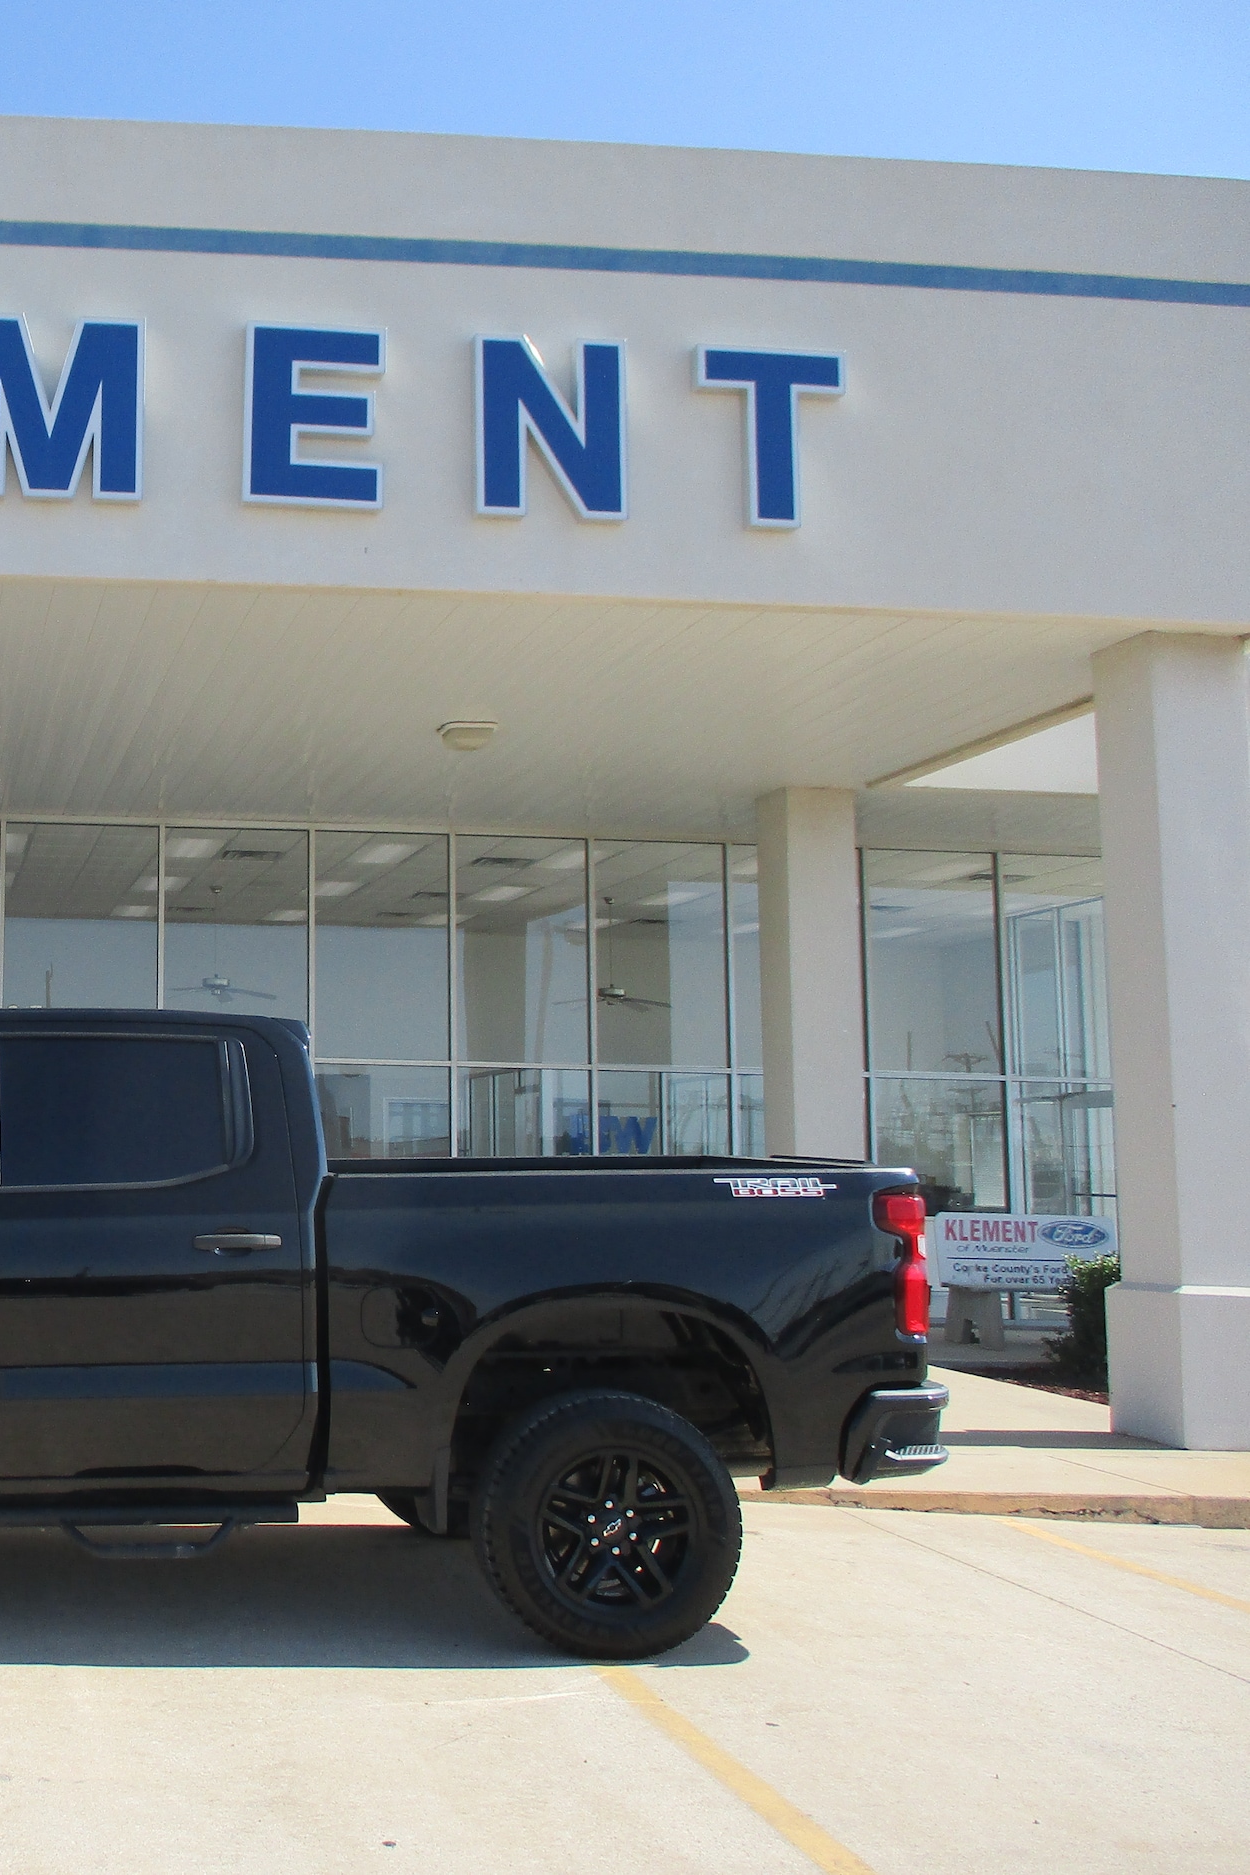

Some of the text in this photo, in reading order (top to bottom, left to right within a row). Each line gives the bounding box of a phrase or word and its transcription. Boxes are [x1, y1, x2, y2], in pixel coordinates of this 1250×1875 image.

[713, 1178, 837, 1189] TRAIL
[731, 1187, 825, 1198] BOSS
[943, 1218, 1039, 1243] KLEMENT
[956, 1244, 971, 1253] of
